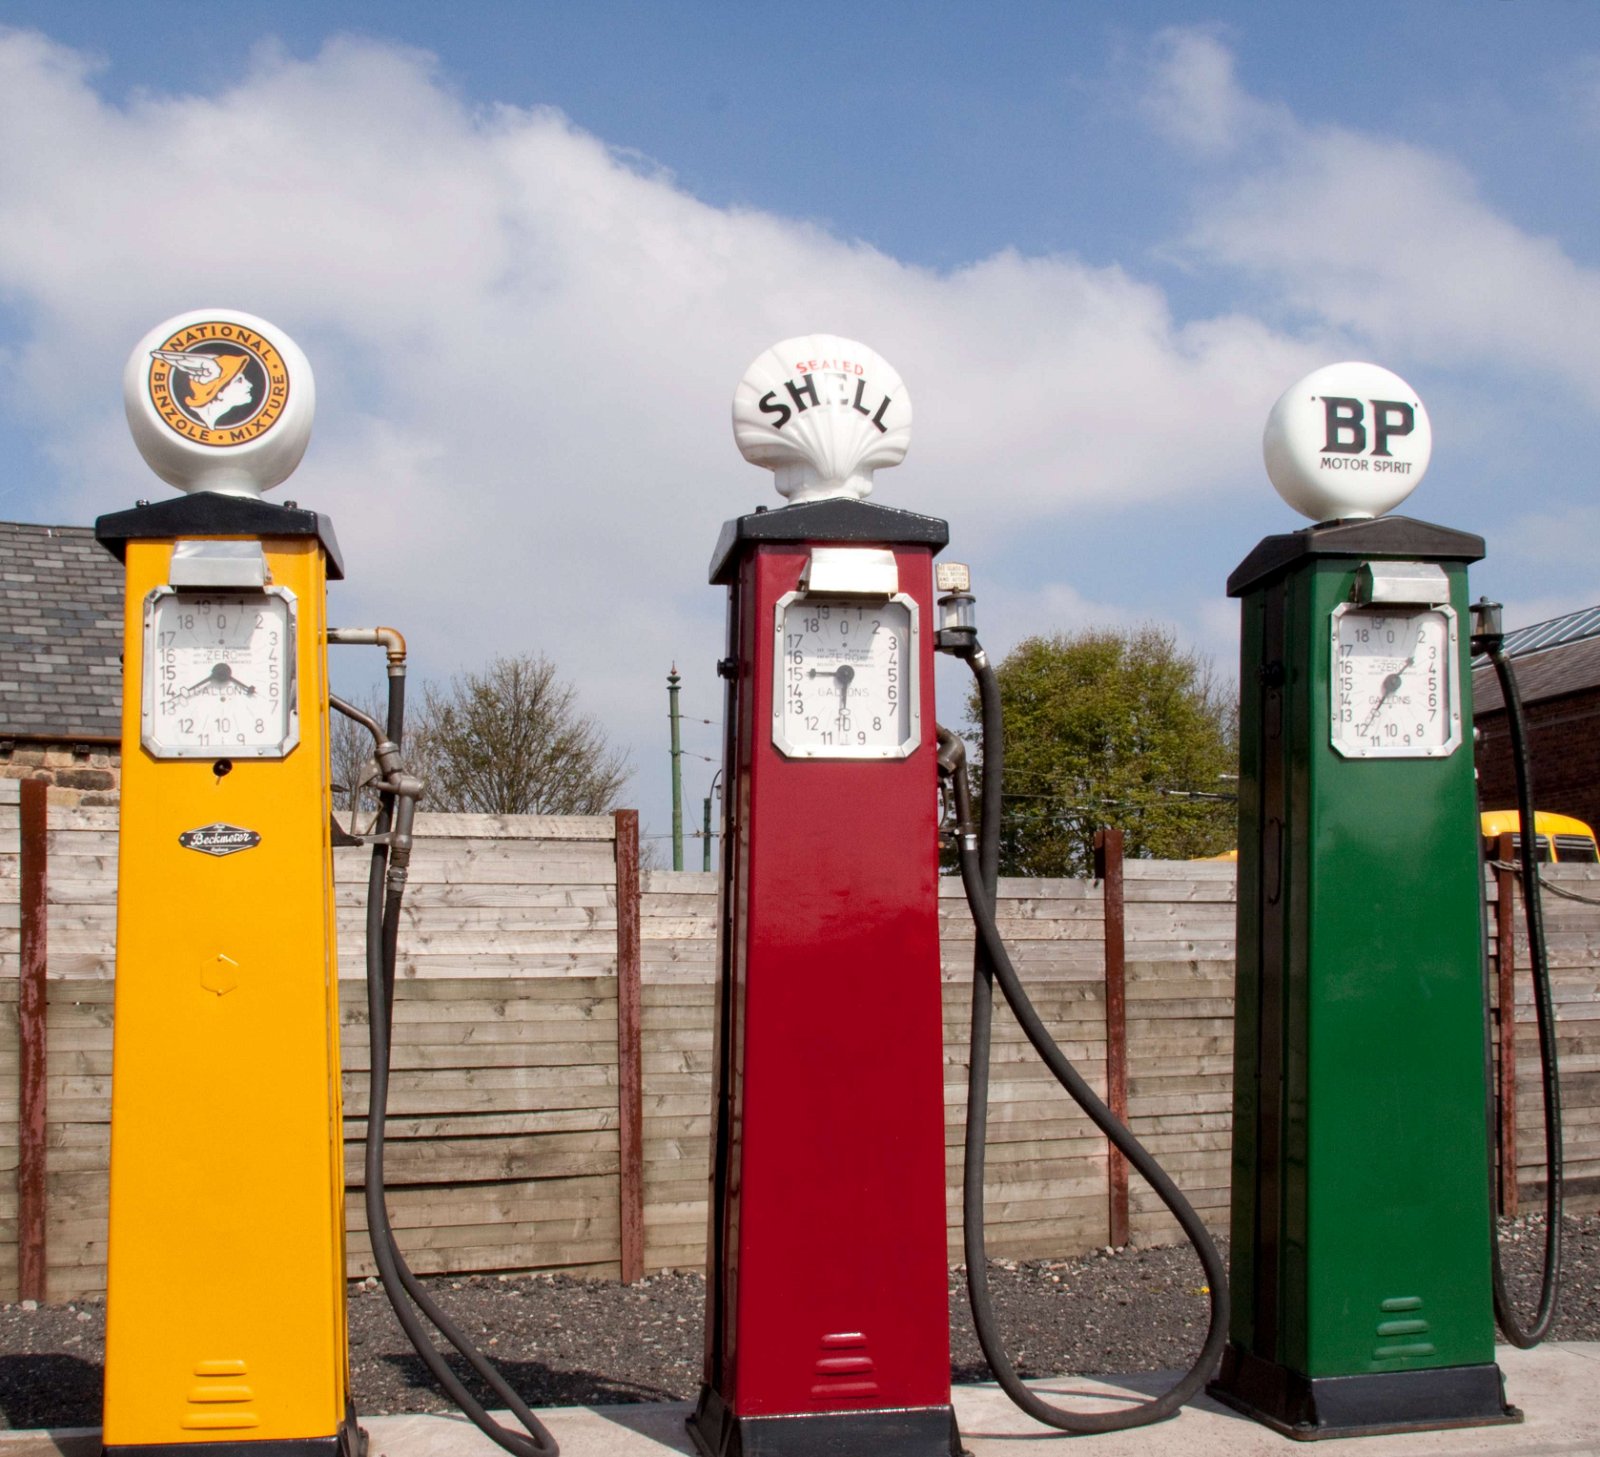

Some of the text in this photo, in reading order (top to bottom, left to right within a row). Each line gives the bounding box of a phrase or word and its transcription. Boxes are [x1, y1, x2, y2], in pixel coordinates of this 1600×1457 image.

[169, 325, 271, 361] NATIONAL
[796, 359, 864, 376] SEALED
[154, 372, 210, 441] BENZOLE
[229, 374, 285, 442] MIXTURE
[1319, 396, 1414, 457] BP
[1320, 457, 1412, 474] MOTOR SPIRIT
[816, 605, 830, 619] 19
[178, 615, 194, 630] 18
[217, 615, 226, 629] 0
[255, 615, 263, 629] 2
[803, 618, 819, 633] 18
[840, 620, 849, 635] 0
[872, 620, 880, 634] 2
[160, 631, 176, 646] 17
[269, 632, 278, 646] 3
[787, 634, 803, 648] 17
[888, 636, 897, 650] 3
[1355, 629, 1369, 643] 18
[1386, 630, 1395, 643] 0
[1418, 630, 1425, 643] 2
[160, 648, 176, 663] 16
[207, 650, 238, 660] ZERO
[269, 648, 277, 661] 4
[788, 650, 803, 665] 16
[1340, 644, 1353, 657] 17
[1428, 646, 1436, 659] 3
[888, 652, 897, 665] 4
[160, 665, 176, 680] 15
[269, 665, 278, 679] 5
[788, 667, 803, 681] 15
[1340, 661, 1352, 674] 16
[1428, 663, 1436, 674] 4
[888, 668, 897, 682] 5
[160, 683, 175, 697] 14
[269, 682, 278, 697] 6
[788, 684, 803, 697] 14
[1340, 678, 1352, 691] 15
[1428, 678, 1436, 691] 5
[818, 687, 870, 697] GALONS
[888, 685, 897, 700] 6
[1340, 693, 1352, 706] 14
[1428, 694, 1436, 707] 6
[160, 701, 176, 715] 13
[269, 700, 278, 714] 7
[788, 700, 803, 714] 13
[888, 702, 898, 716] 7
[1340, 709, 1352, 722] 13
[1428, 709, 1437, 722] 7
[179, 719, 194, 733] 12
[216, 718, 230, 733] 10
[255, 719, 264, 733] 8
[804, 716, 819, 731] 12
[836, 717, 851, 731] 10
[872, 716, 881, 731] 8
[1354, 723, 1367, 737] 12
[1384, 723, 1398, 737] 10
[1416, 723, 1424, 737] 8
[198, 734, 209, 746] 11
[237, 733, 245, 746] 9
[821, 731, 833, 745] 11
[857, 731, 866, 745] 9
[1370, 736, 1380, 747] 11
[1403, 734, 1411, 746] 9
[190, 832, 252, 847] Beckmeter
